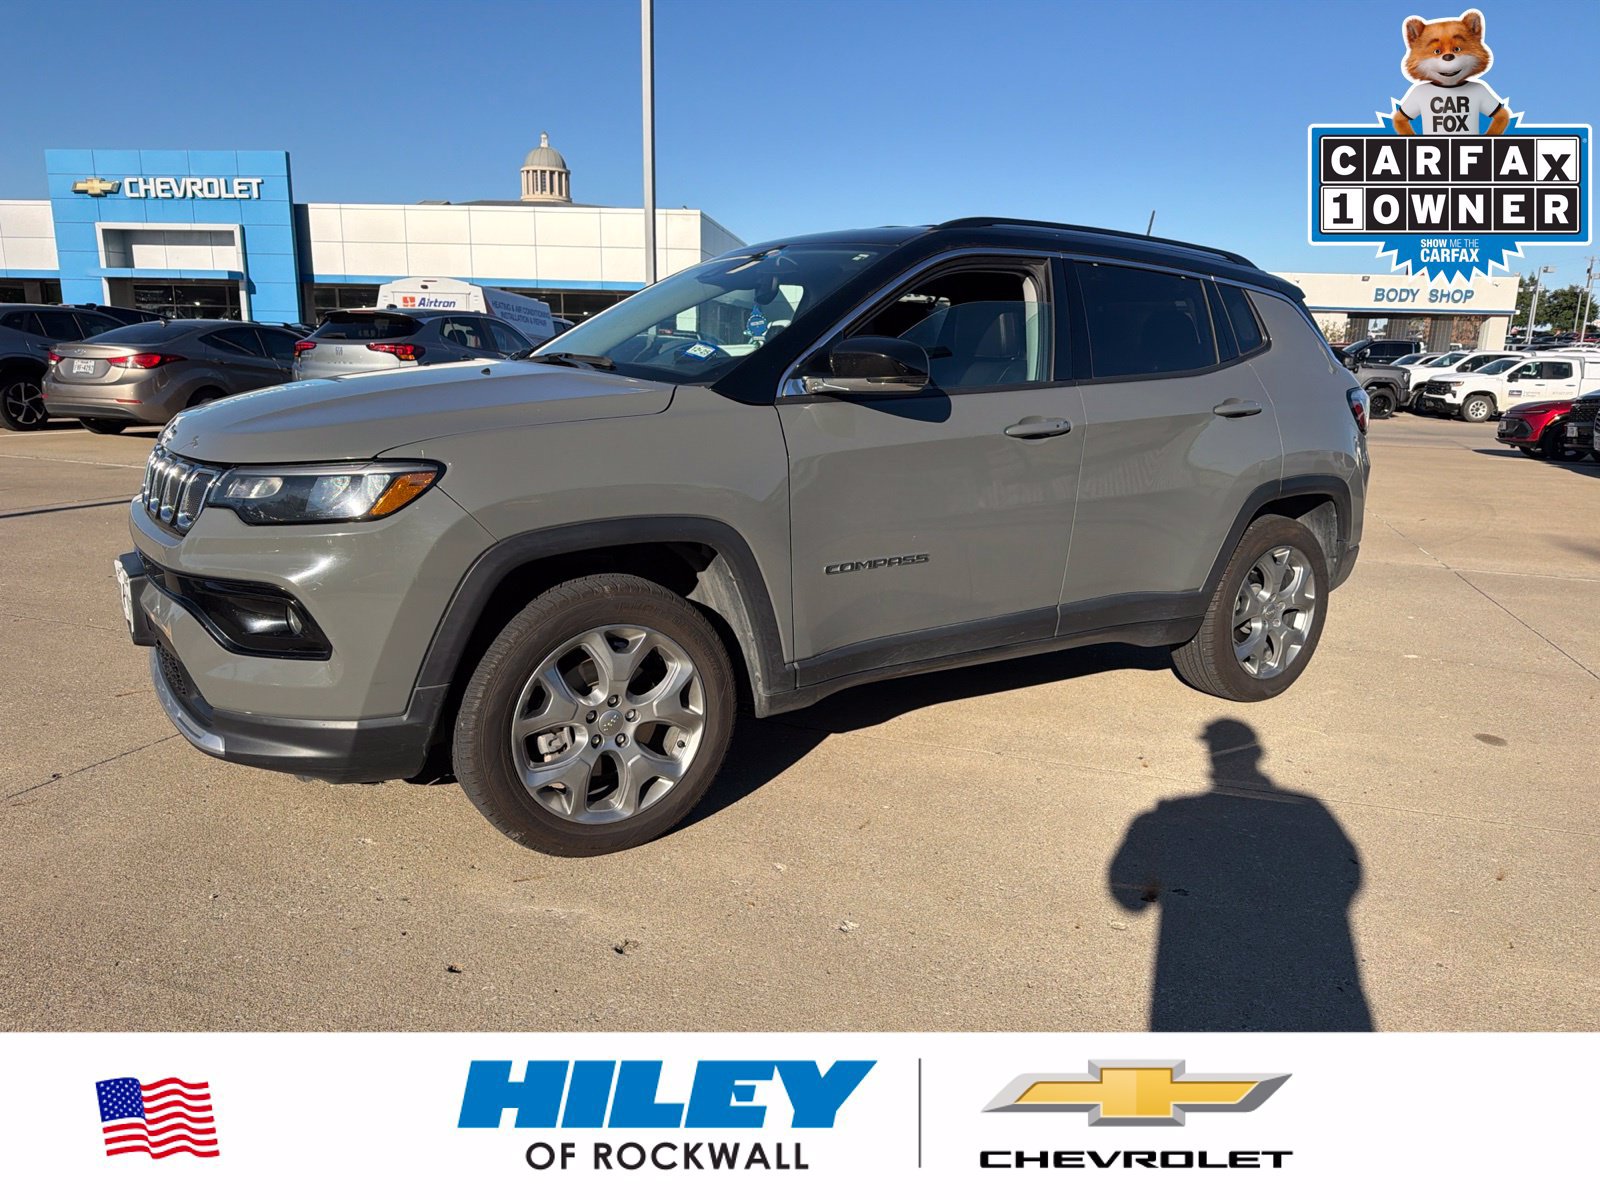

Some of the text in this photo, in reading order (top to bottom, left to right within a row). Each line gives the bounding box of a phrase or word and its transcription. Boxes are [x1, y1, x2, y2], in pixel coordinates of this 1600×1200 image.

[124, 177, 263, 199] CHEVROLET
[417, 297, 456, 308] Airtron
[1374, 287, 1475, 304] BODY SHOP
[824, 553, 930, 576] COMPASS
